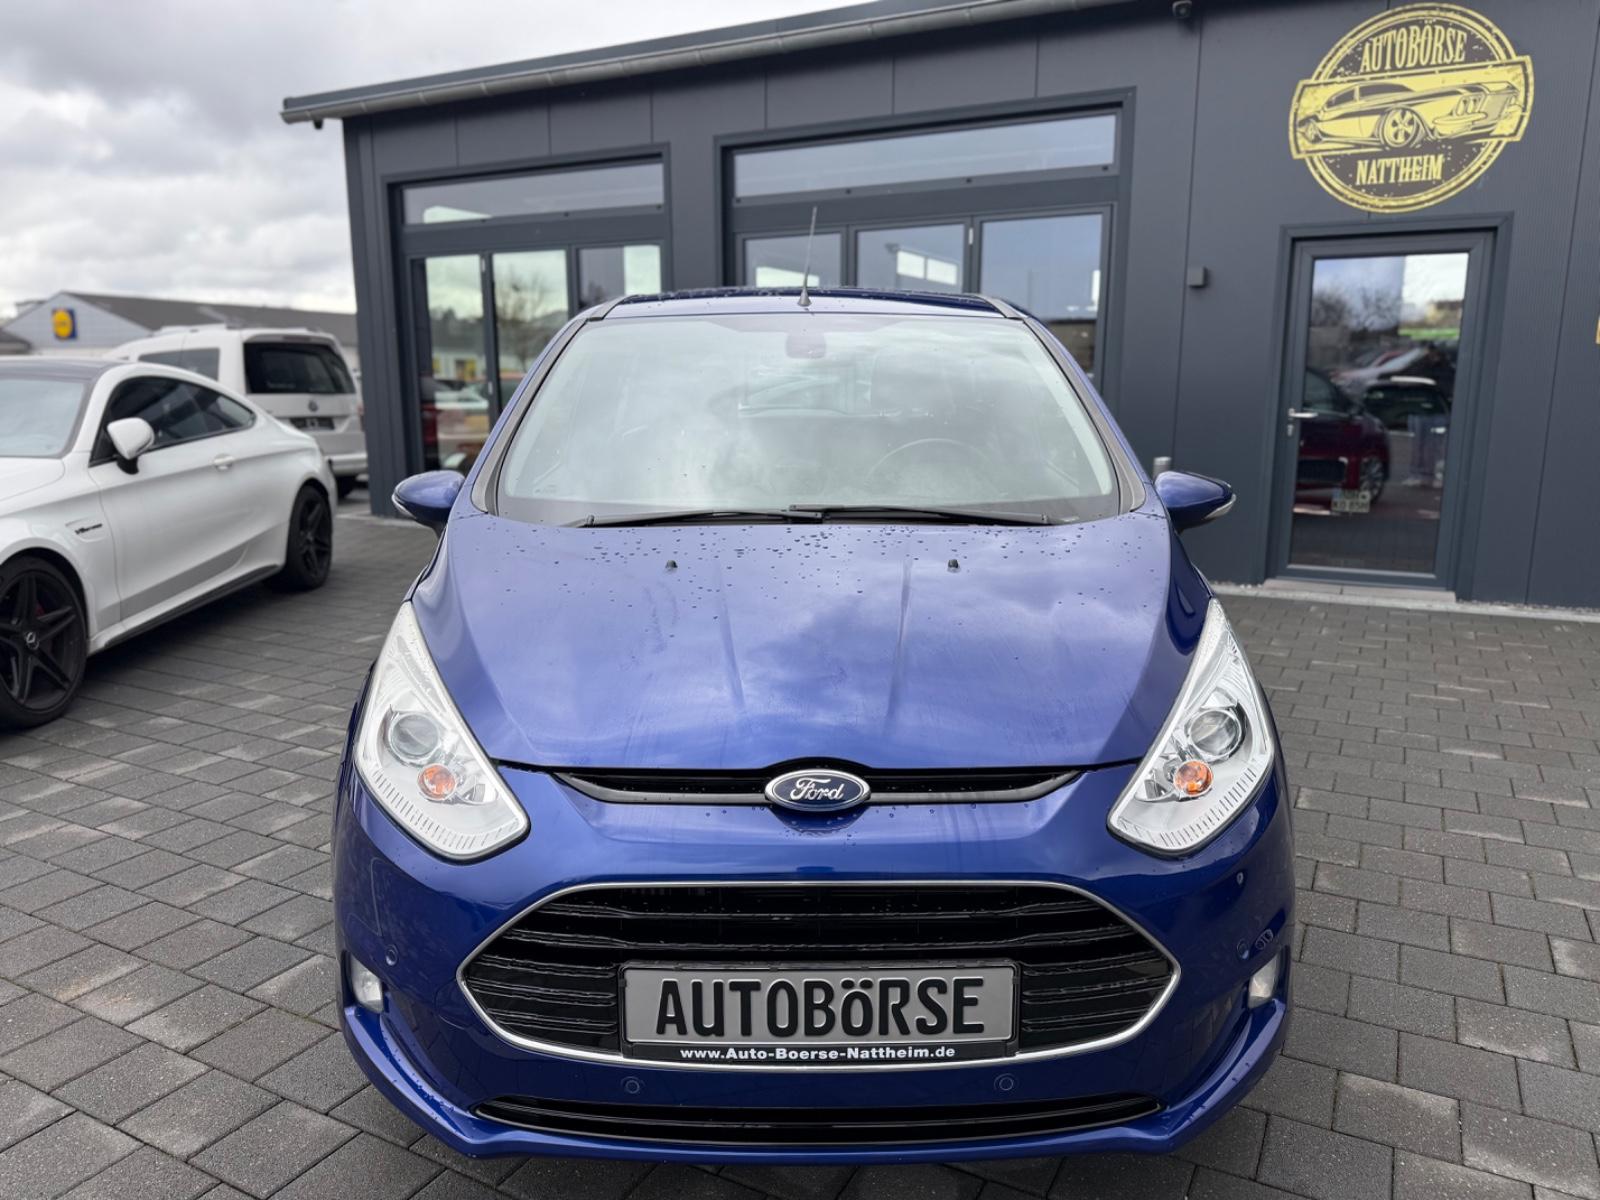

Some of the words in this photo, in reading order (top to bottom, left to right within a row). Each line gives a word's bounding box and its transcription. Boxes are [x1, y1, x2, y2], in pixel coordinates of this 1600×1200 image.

[1360, 20, 1468, 73] AUTOBÖRSE
[1355, 154, 1445, 186] NATTHEIM
[789, 777, 845, 801] Ford
[656, 977, 985, 1037] AUTOBÖRSE
[680, 1046, 956, 1061] www.Auto-Boerse-Nattheim.de
